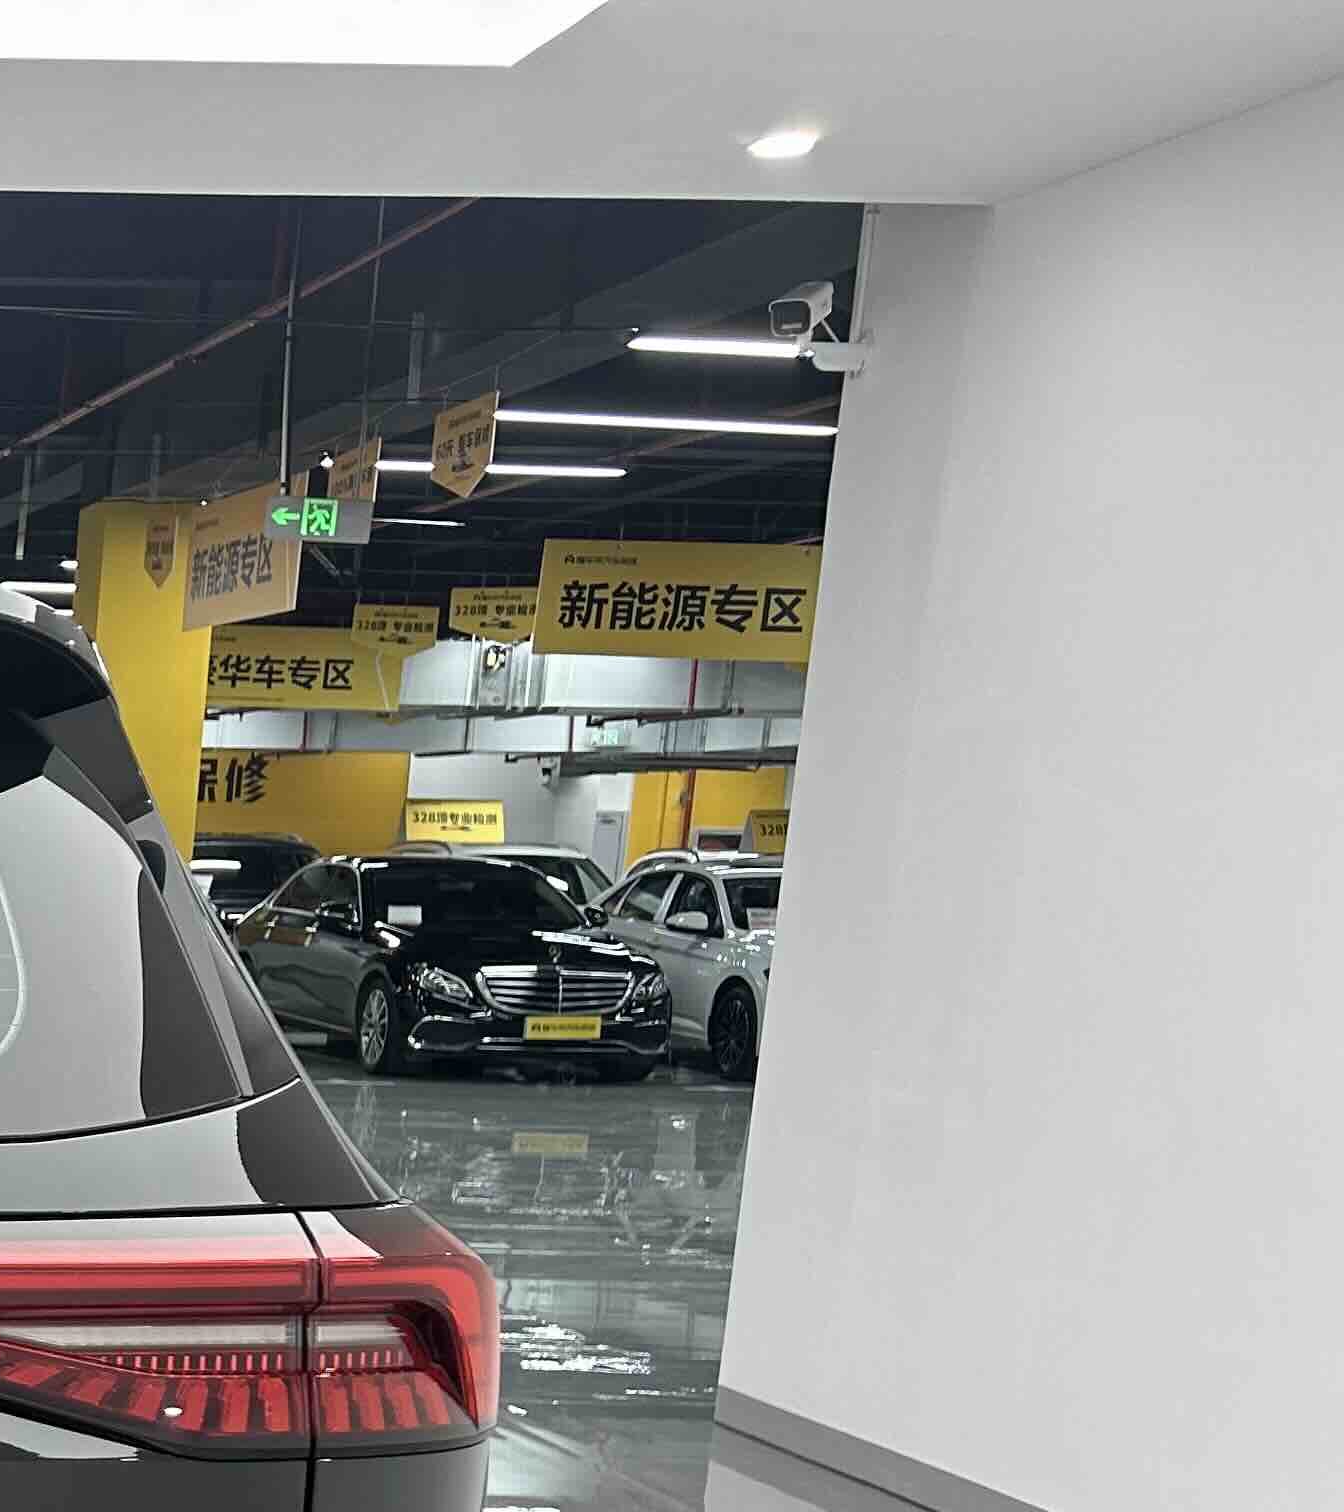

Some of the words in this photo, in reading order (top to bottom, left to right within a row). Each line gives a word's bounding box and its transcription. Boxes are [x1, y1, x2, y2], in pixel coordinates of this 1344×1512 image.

[191, 532, 273, 600] 新能源专区
[558, 579, 807, 633] 新能源专区
